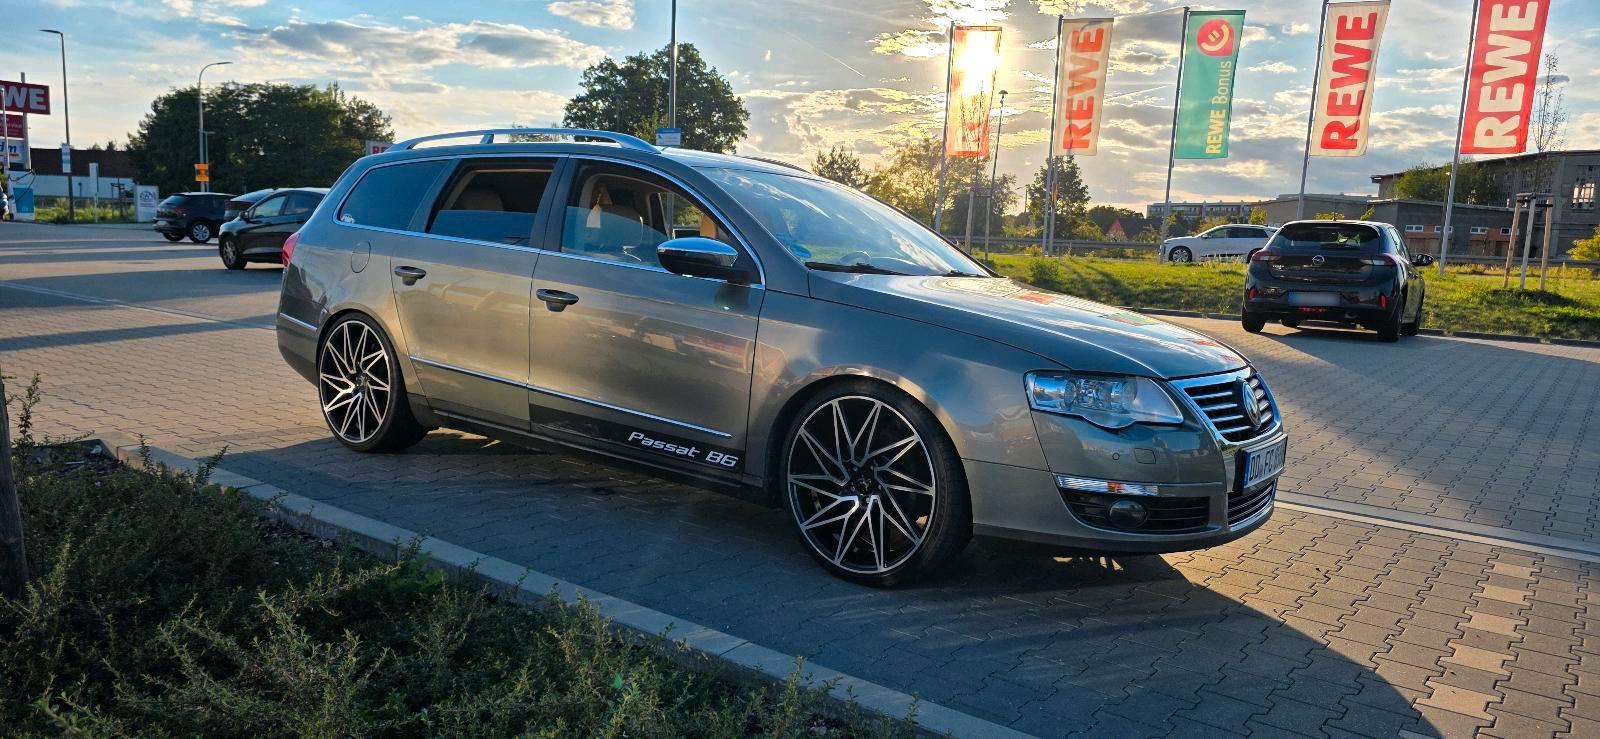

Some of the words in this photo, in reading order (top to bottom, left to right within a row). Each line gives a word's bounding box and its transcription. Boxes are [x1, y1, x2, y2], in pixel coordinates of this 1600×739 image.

[1062, 28, 1104, 149] REWE
[1211, 60, 1232, 104] Bonus
[1320, 12, 1377, 149] REWE
[1472, 1, 1538, 149] REWE
[1205, 109, 1227, 154] REWE
[627, 431, 700, 458] Passat
[705, 451, 739, 468] B6
[1248, 454, 1261, 482] DD
